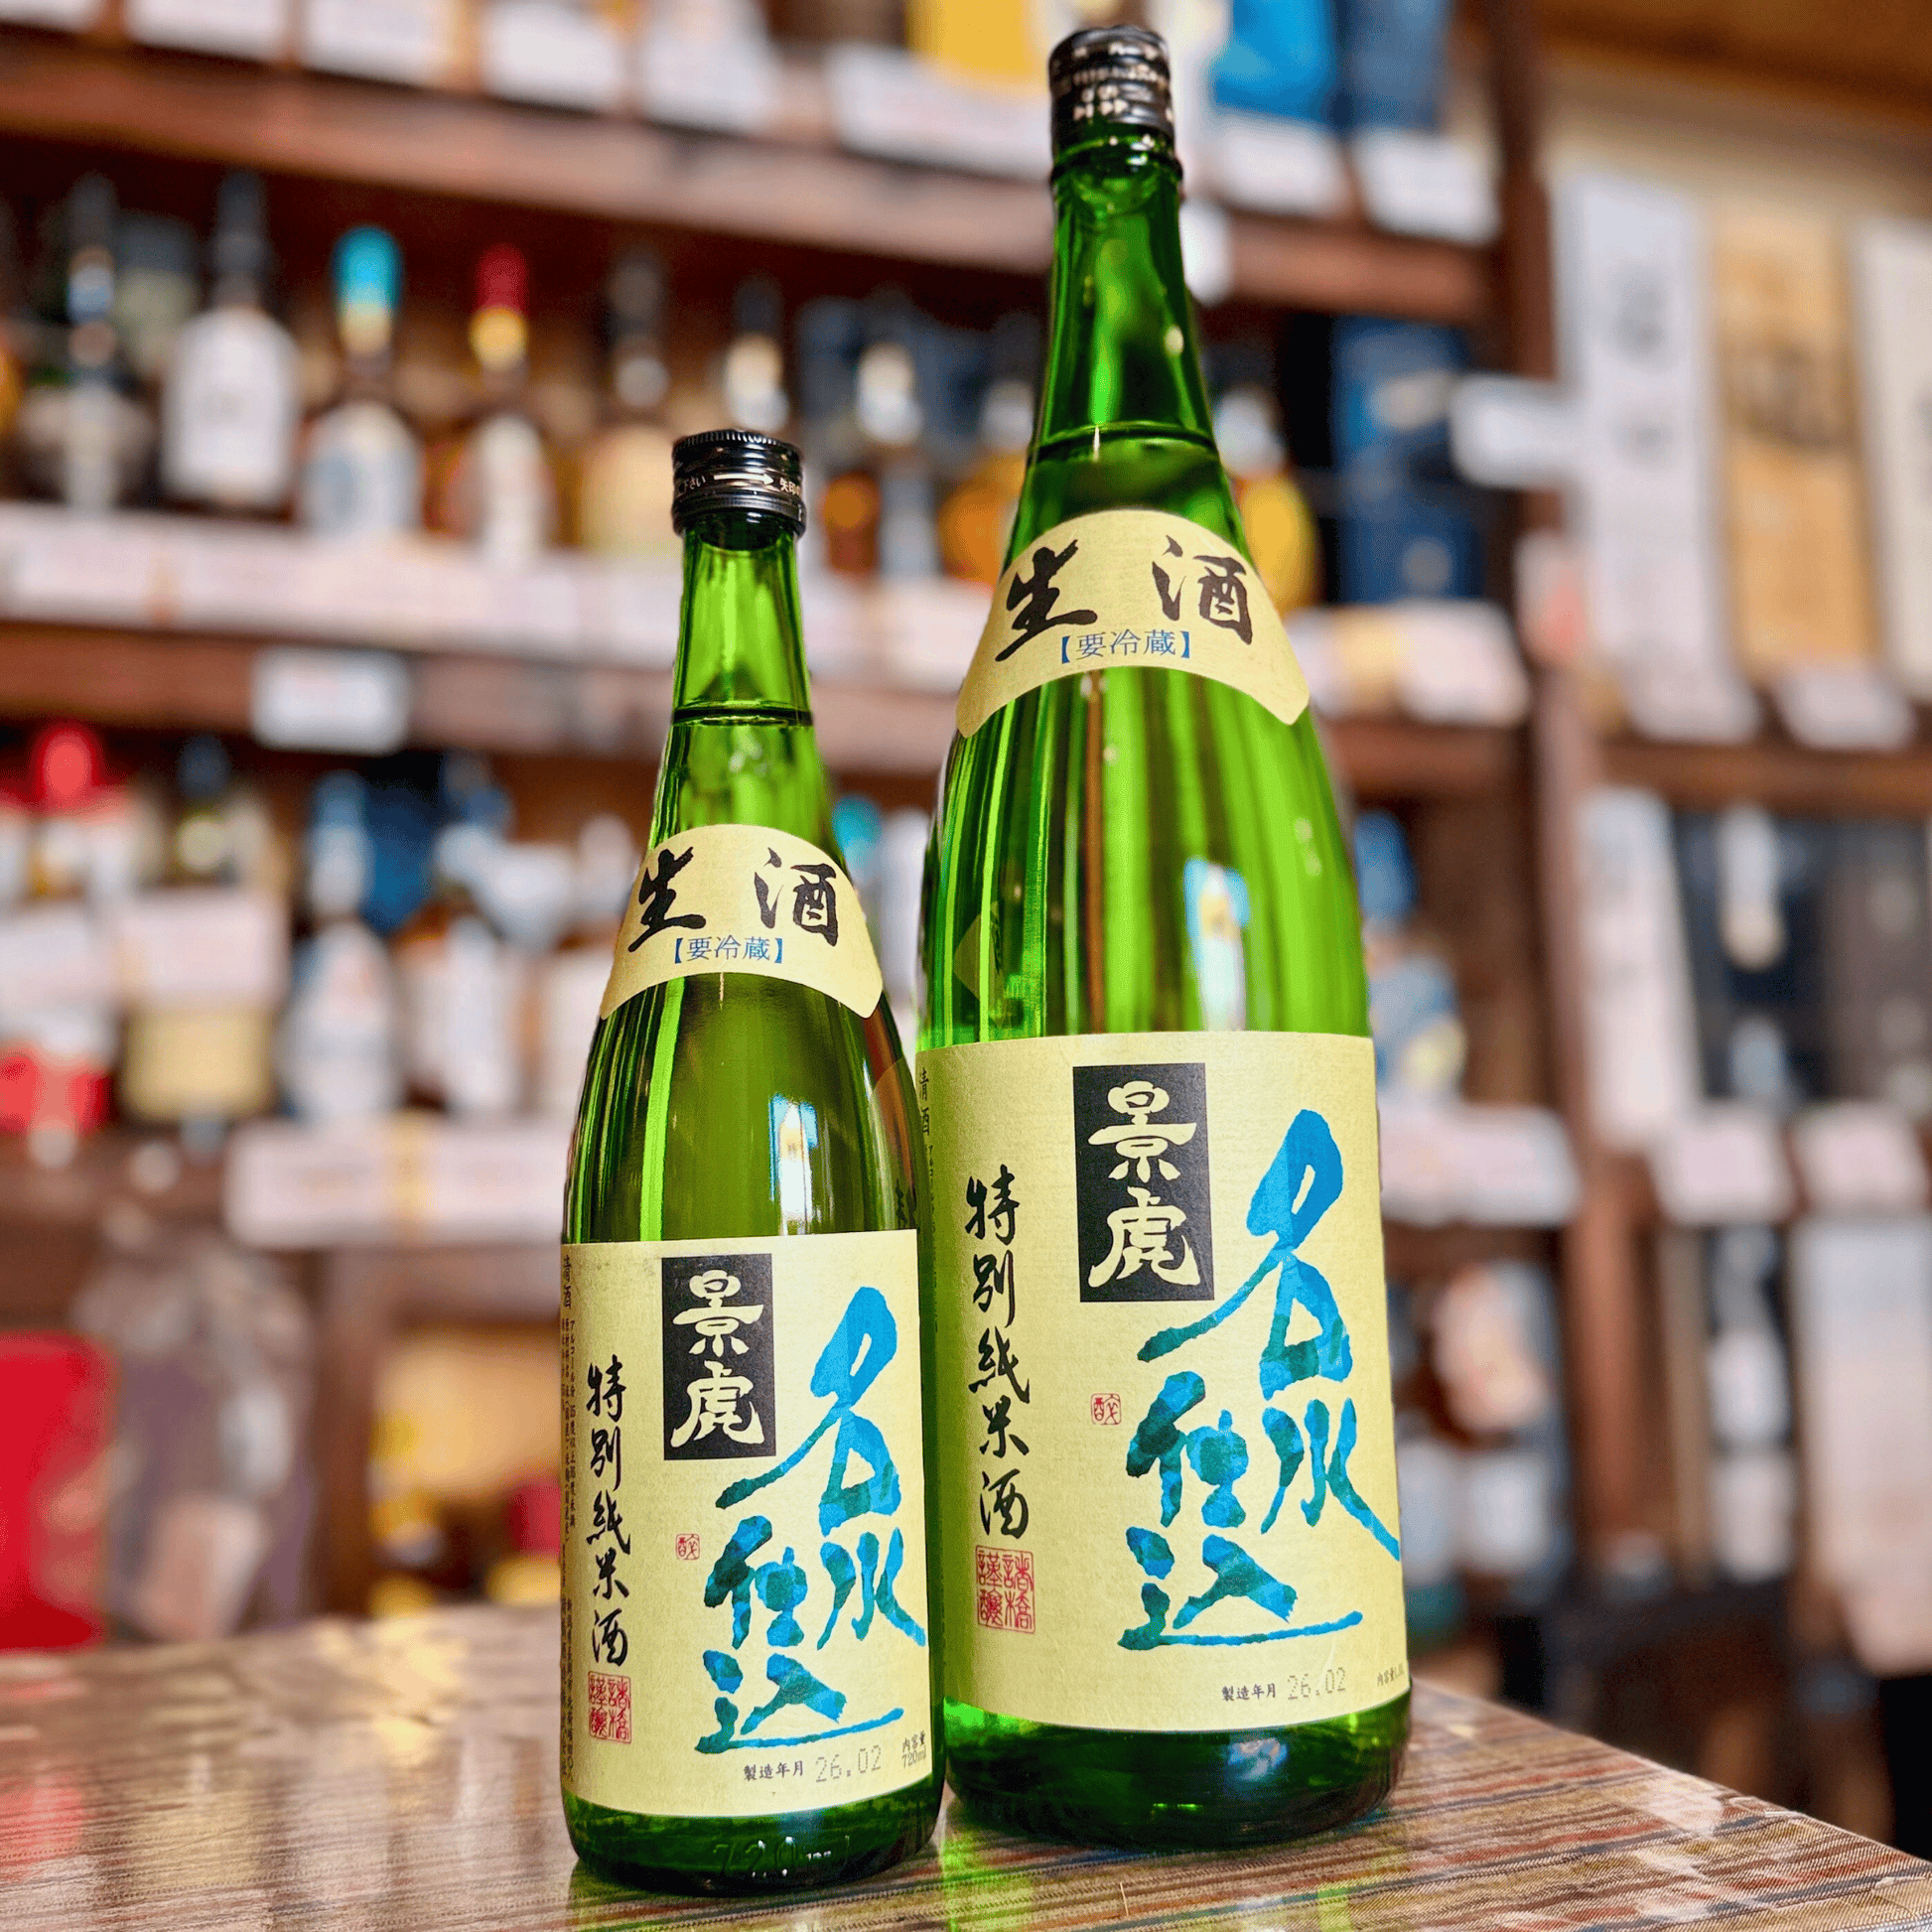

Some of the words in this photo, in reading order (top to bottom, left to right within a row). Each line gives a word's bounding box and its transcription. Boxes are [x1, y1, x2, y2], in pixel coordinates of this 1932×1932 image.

[995, 534, 1252, 661] 生酒
[627, 846, 838, 953] 生酒
[1088, 1079, 1201, 1289] 景虎
[671, 1269, 764, 1449] 景虎
[1221, 1683, 1277, 1702] 製造年月
[1287, 1667, 1346, 1701] 26.02
[743, 1760, 804, 1782] 製造年月
[815, 1744, 882, 1784] 26.02
